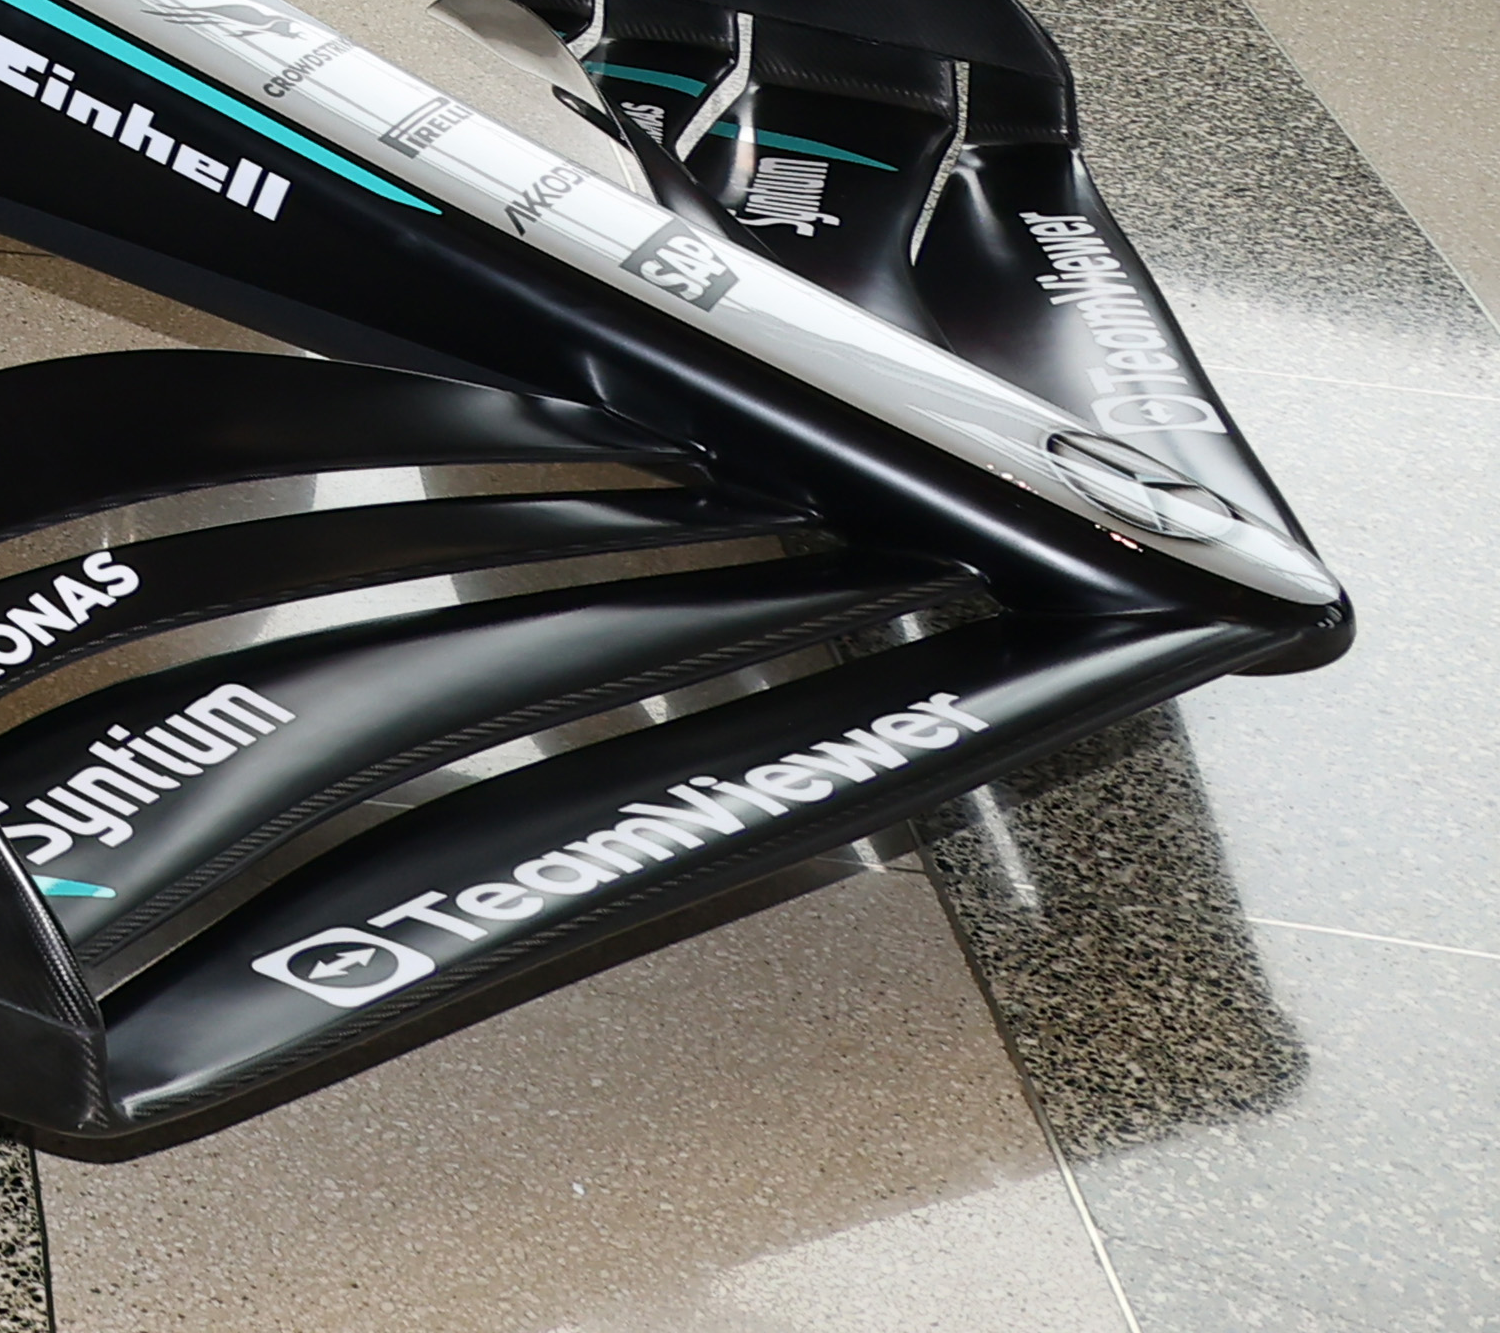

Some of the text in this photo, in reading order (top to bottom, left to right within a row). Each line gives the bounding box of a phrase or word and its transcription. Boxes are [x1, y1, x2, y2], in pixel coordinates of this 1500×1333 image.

[378, 96, 475, 159] PIRELLI
[640, 235, 727, 301] SAP
[1018, 211, 1204, 395] TeamViewer
[367, 690, 990, 943] TeamViewer
